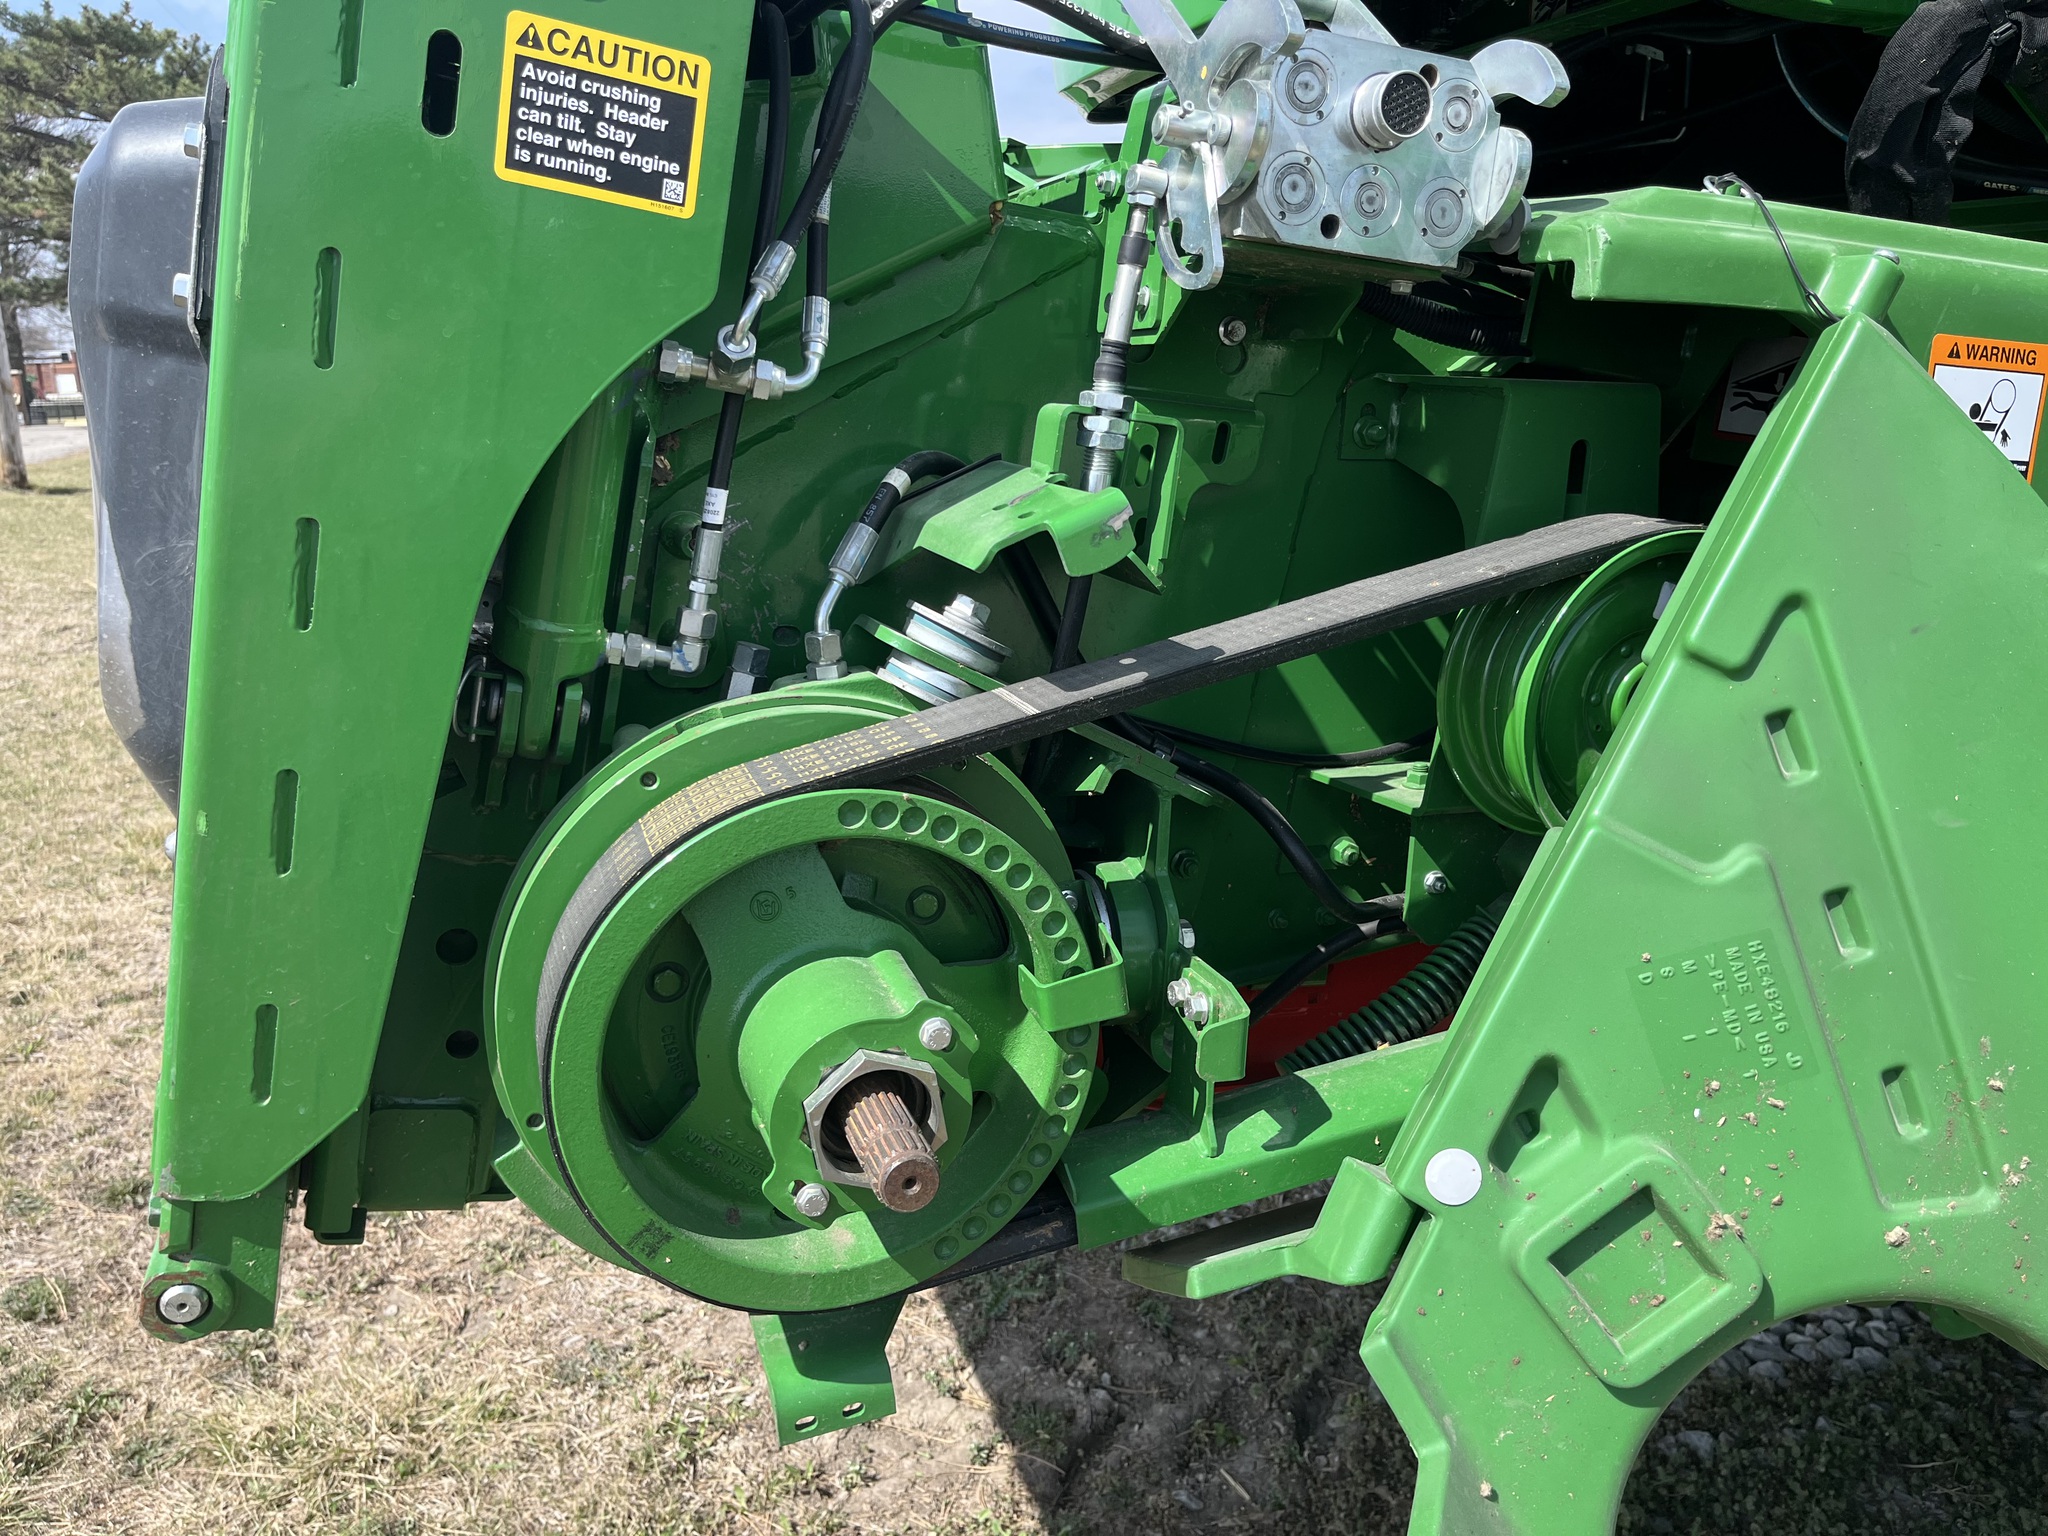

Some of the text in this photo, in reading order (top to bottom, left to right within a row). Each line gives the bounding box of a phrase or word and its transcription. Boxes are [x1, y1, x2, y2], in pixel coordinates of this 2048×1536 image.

[1109, 22, 1131, 39] 225
[547, 28, 700, 89] CAUTION
[519, 83, 669, 132] injuries. Header
[521, 62, 662, 113] Avoid crushing
[517, 106, 637, 148] can tilt. Stay
[514, 144, 612, 182] is running.
[515, 126, 681, 175] clear when engine
[1966, 343, 2037, 366] WARNING
[1638, 971, 1653, 985] D
[1681, 959, 1698, 974] M
[1748, 940, 1789, 1034] HXE48216
[1725, 946, 1778, 1068] MADE IN USA
